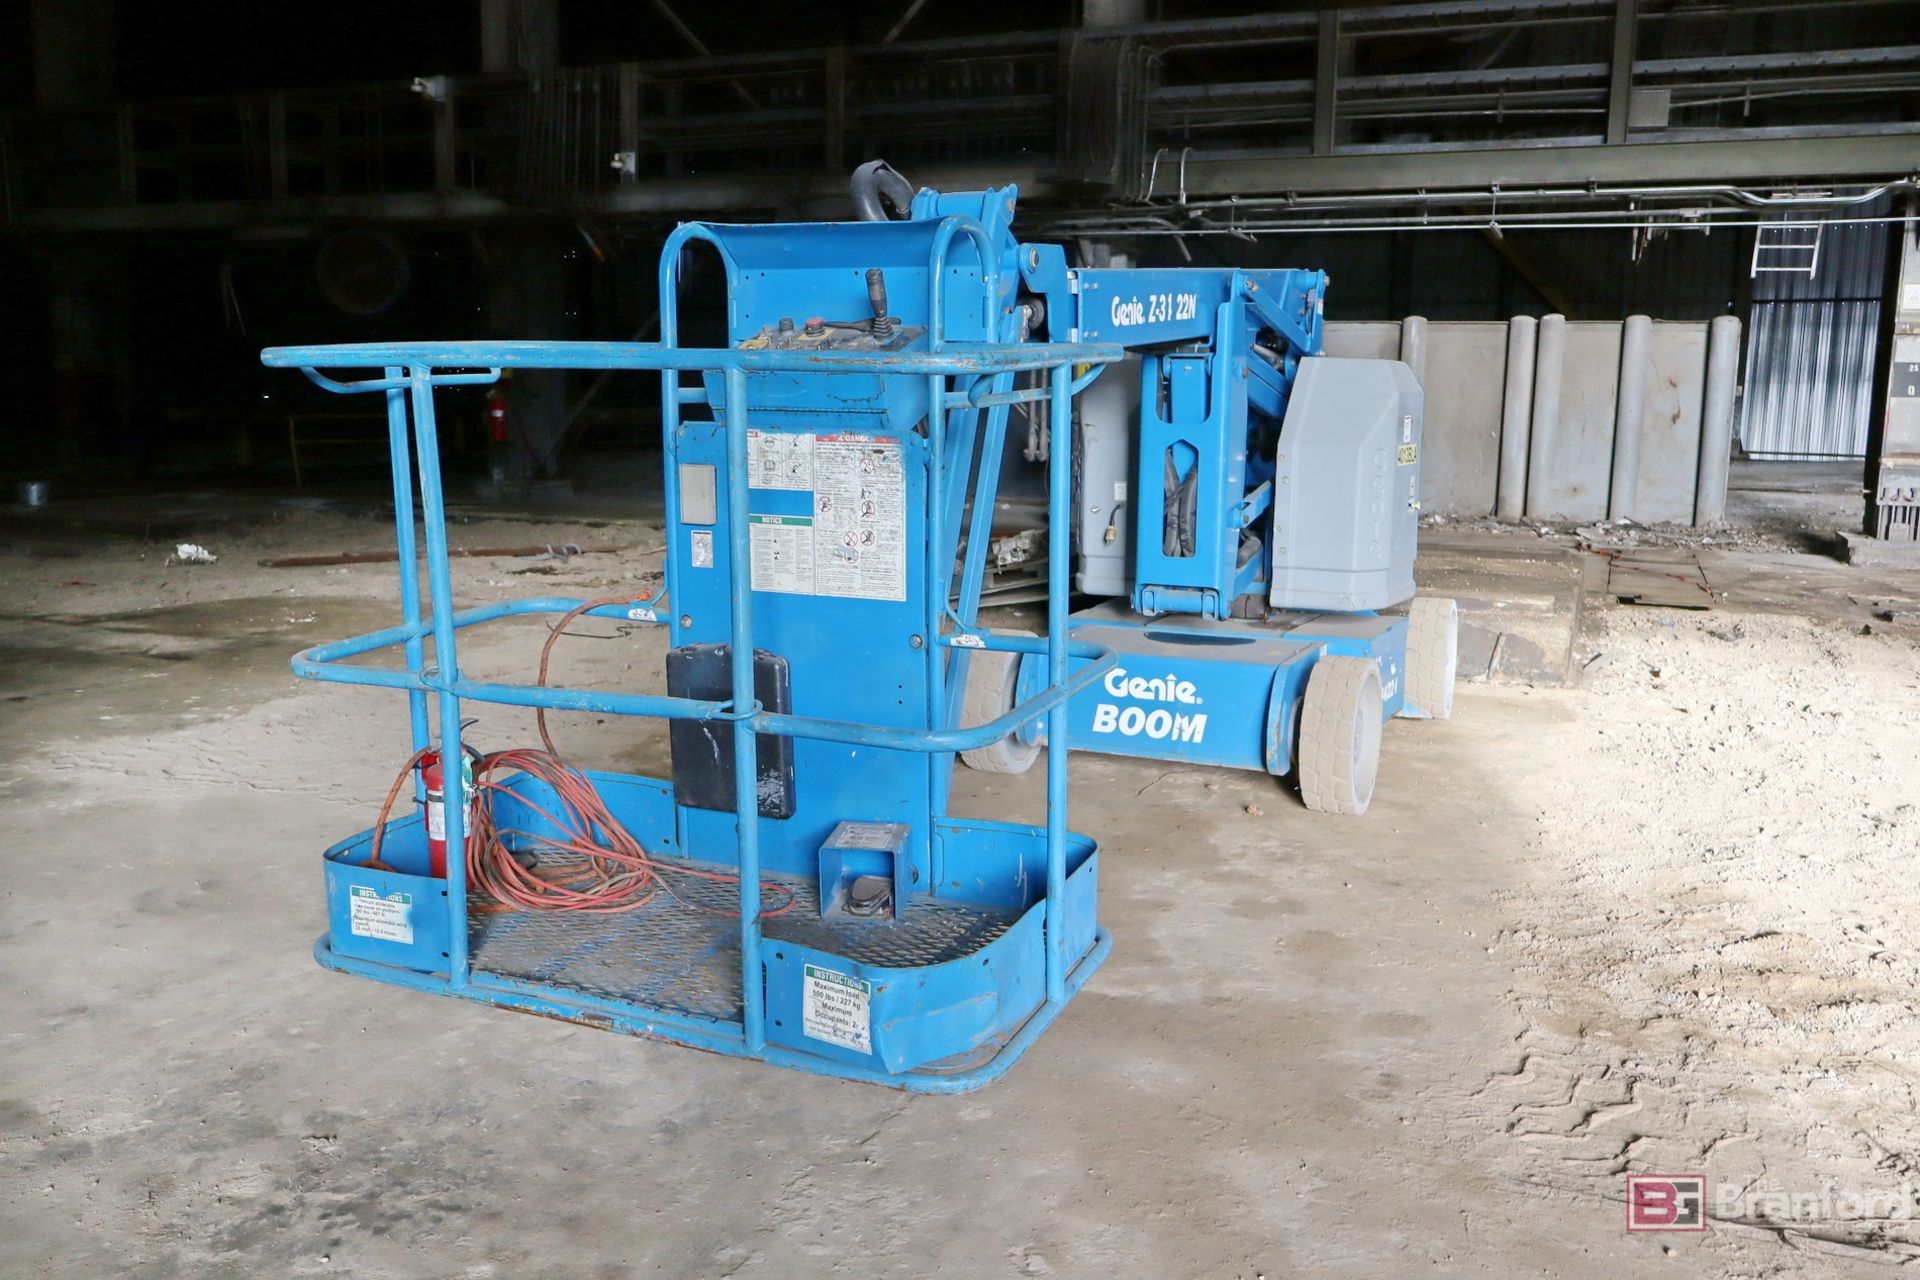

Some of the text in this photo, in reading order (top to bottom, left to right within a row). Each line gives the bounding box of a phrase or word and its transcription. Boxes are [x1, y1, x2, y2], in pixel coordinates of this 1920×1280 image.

[1111, 295, 1145, 327] Genie
[1104, 668, 1197, 704] Genie
[1092, 703, 1208, 744] BOOM
[812, 990, 824, 998] 500
[825, 993, 835, 1002] lbs
[840, 997, 851, 1006] 227
[853, 999, 861, 1011] kg
[814, 981, 860, 1000] Maximum load
[822, 1002, 852, 1017] Maximum
